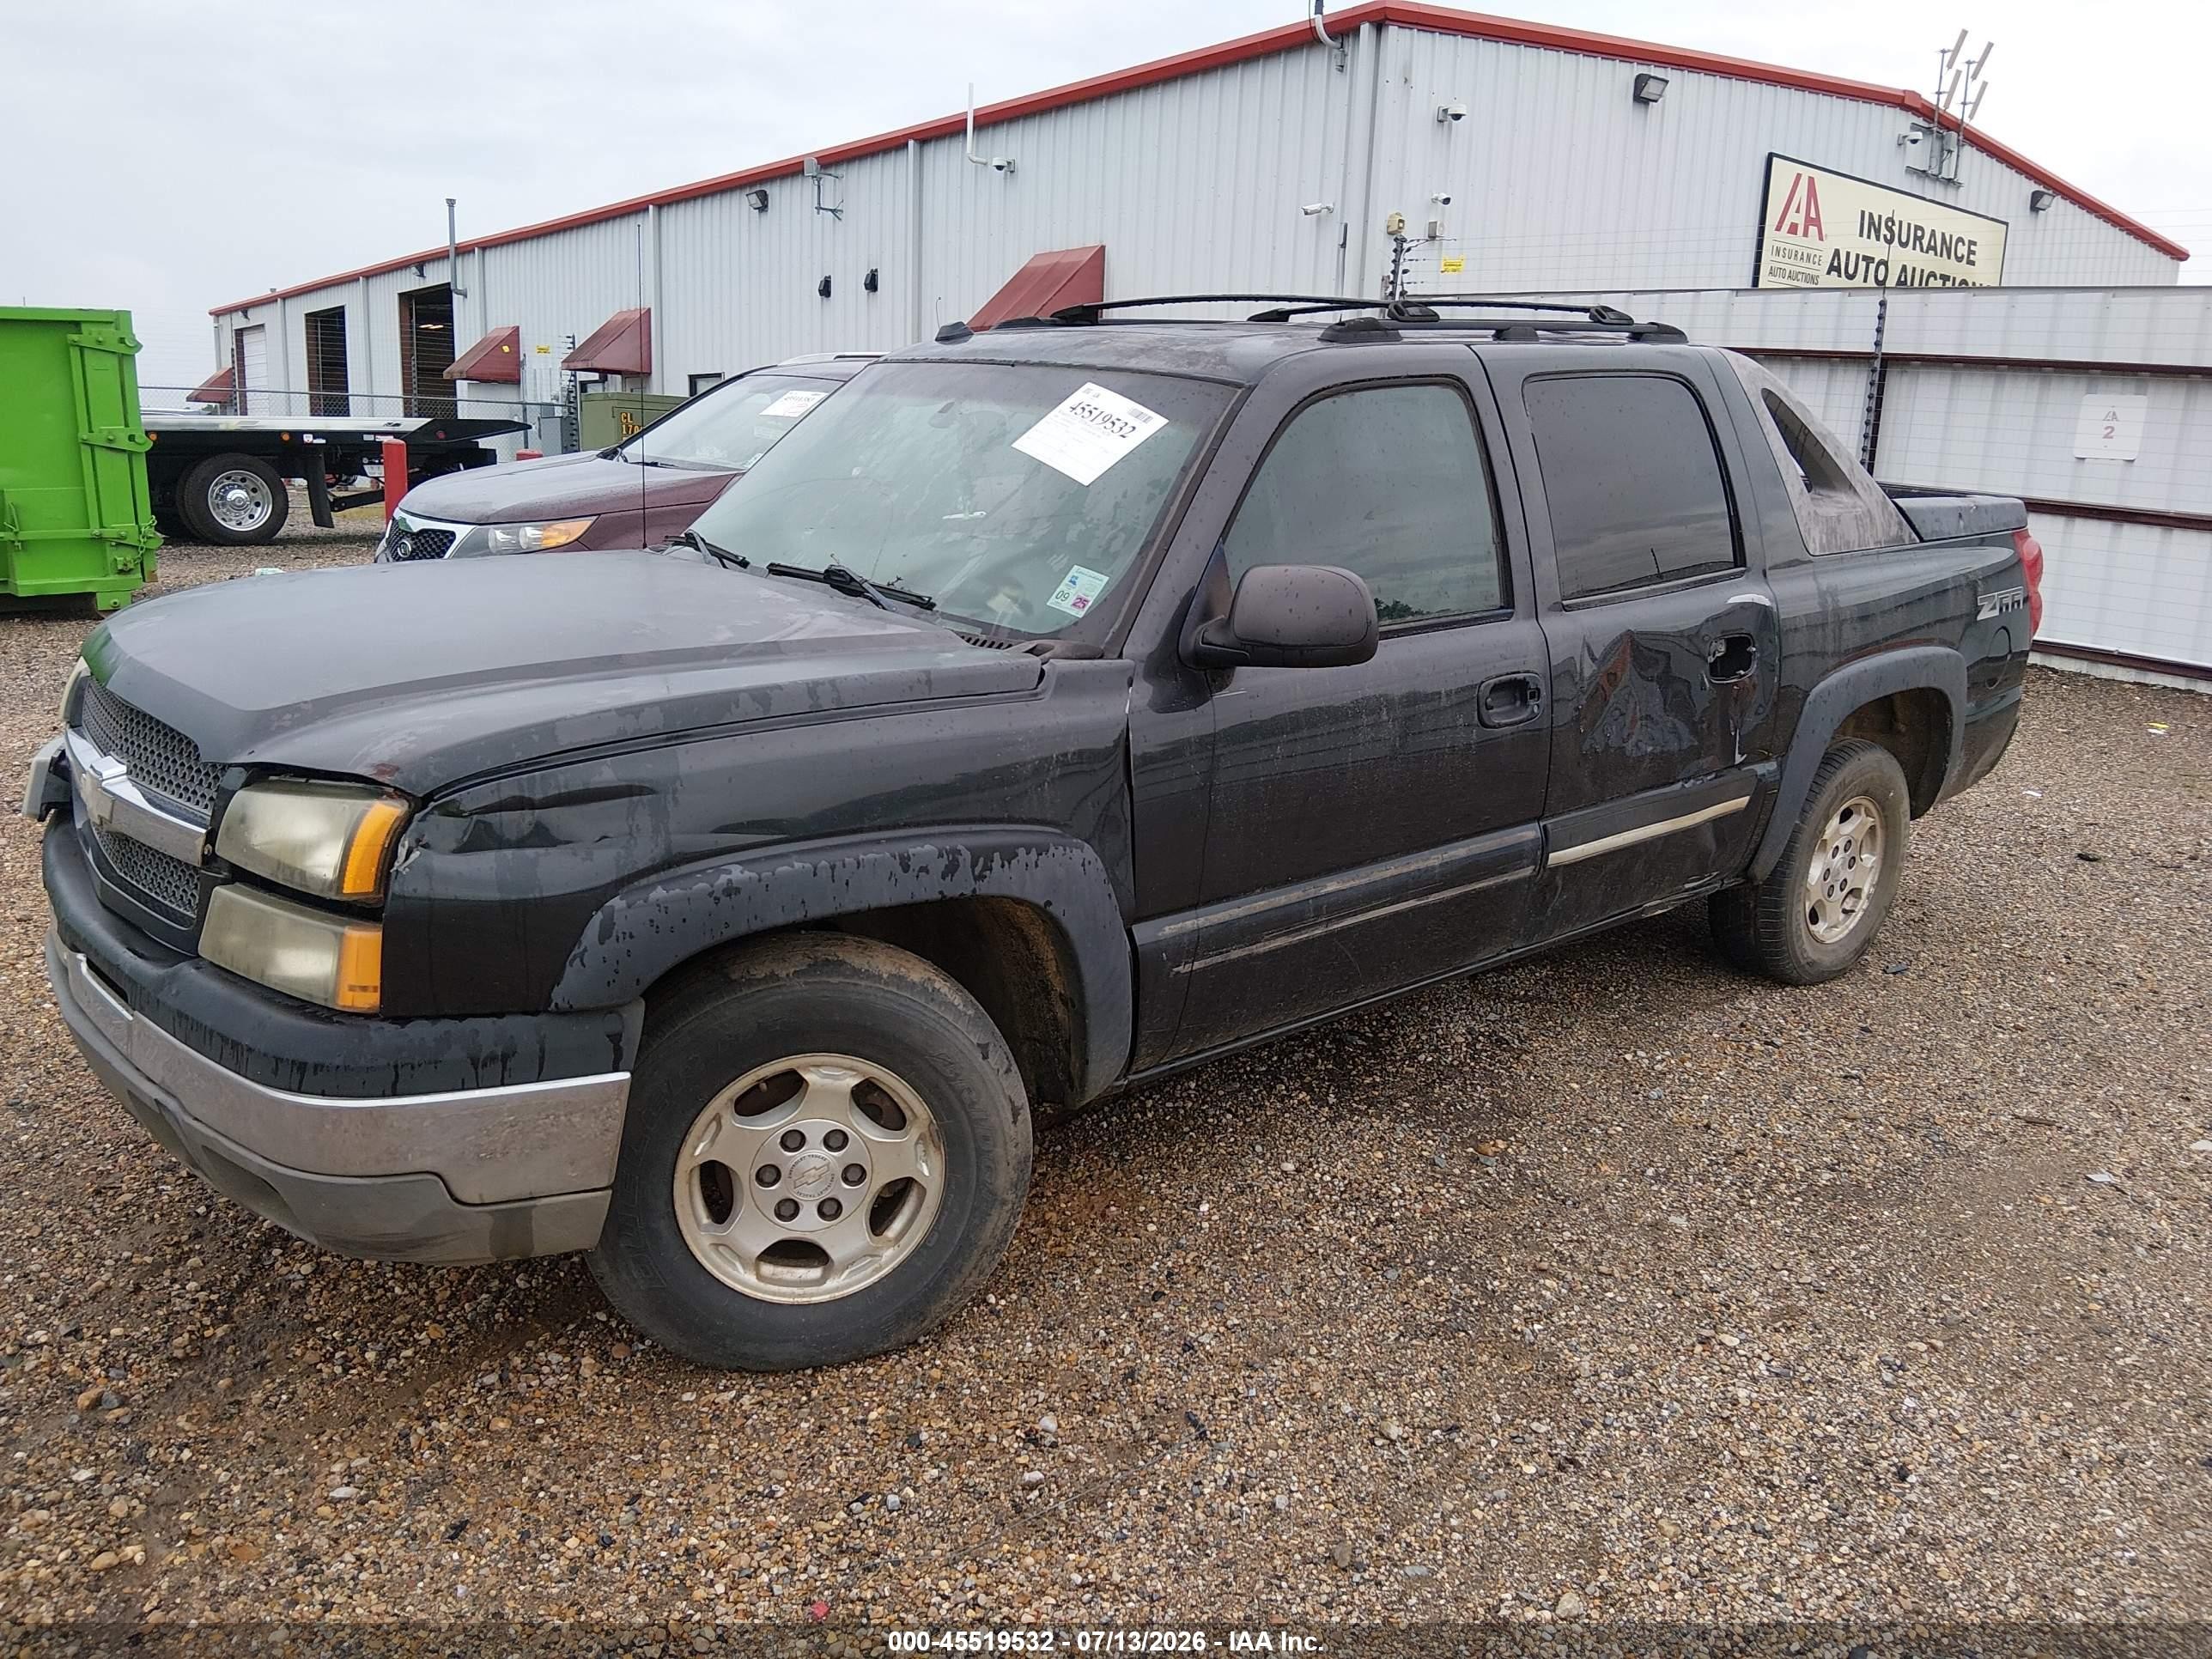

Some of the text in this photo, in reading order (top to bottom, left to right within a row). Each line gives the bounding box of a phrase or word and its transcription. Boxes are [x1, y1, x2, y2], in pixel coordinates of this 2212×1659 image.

[1858, 210, 1978, 266] INSURANCE
[1771, 246, 1823, 266] INSURANCE
[1768, 266, 1820, 286] AUTO AUCTIONS
[1826, 248, 1889, 286] AUTO
[621, 412, 633, 423] CL
[1069, 401, 1136, 438] 45519532
[2102, 426, 2115, 439] 2
[1055, 590, 1070, 602] 09
